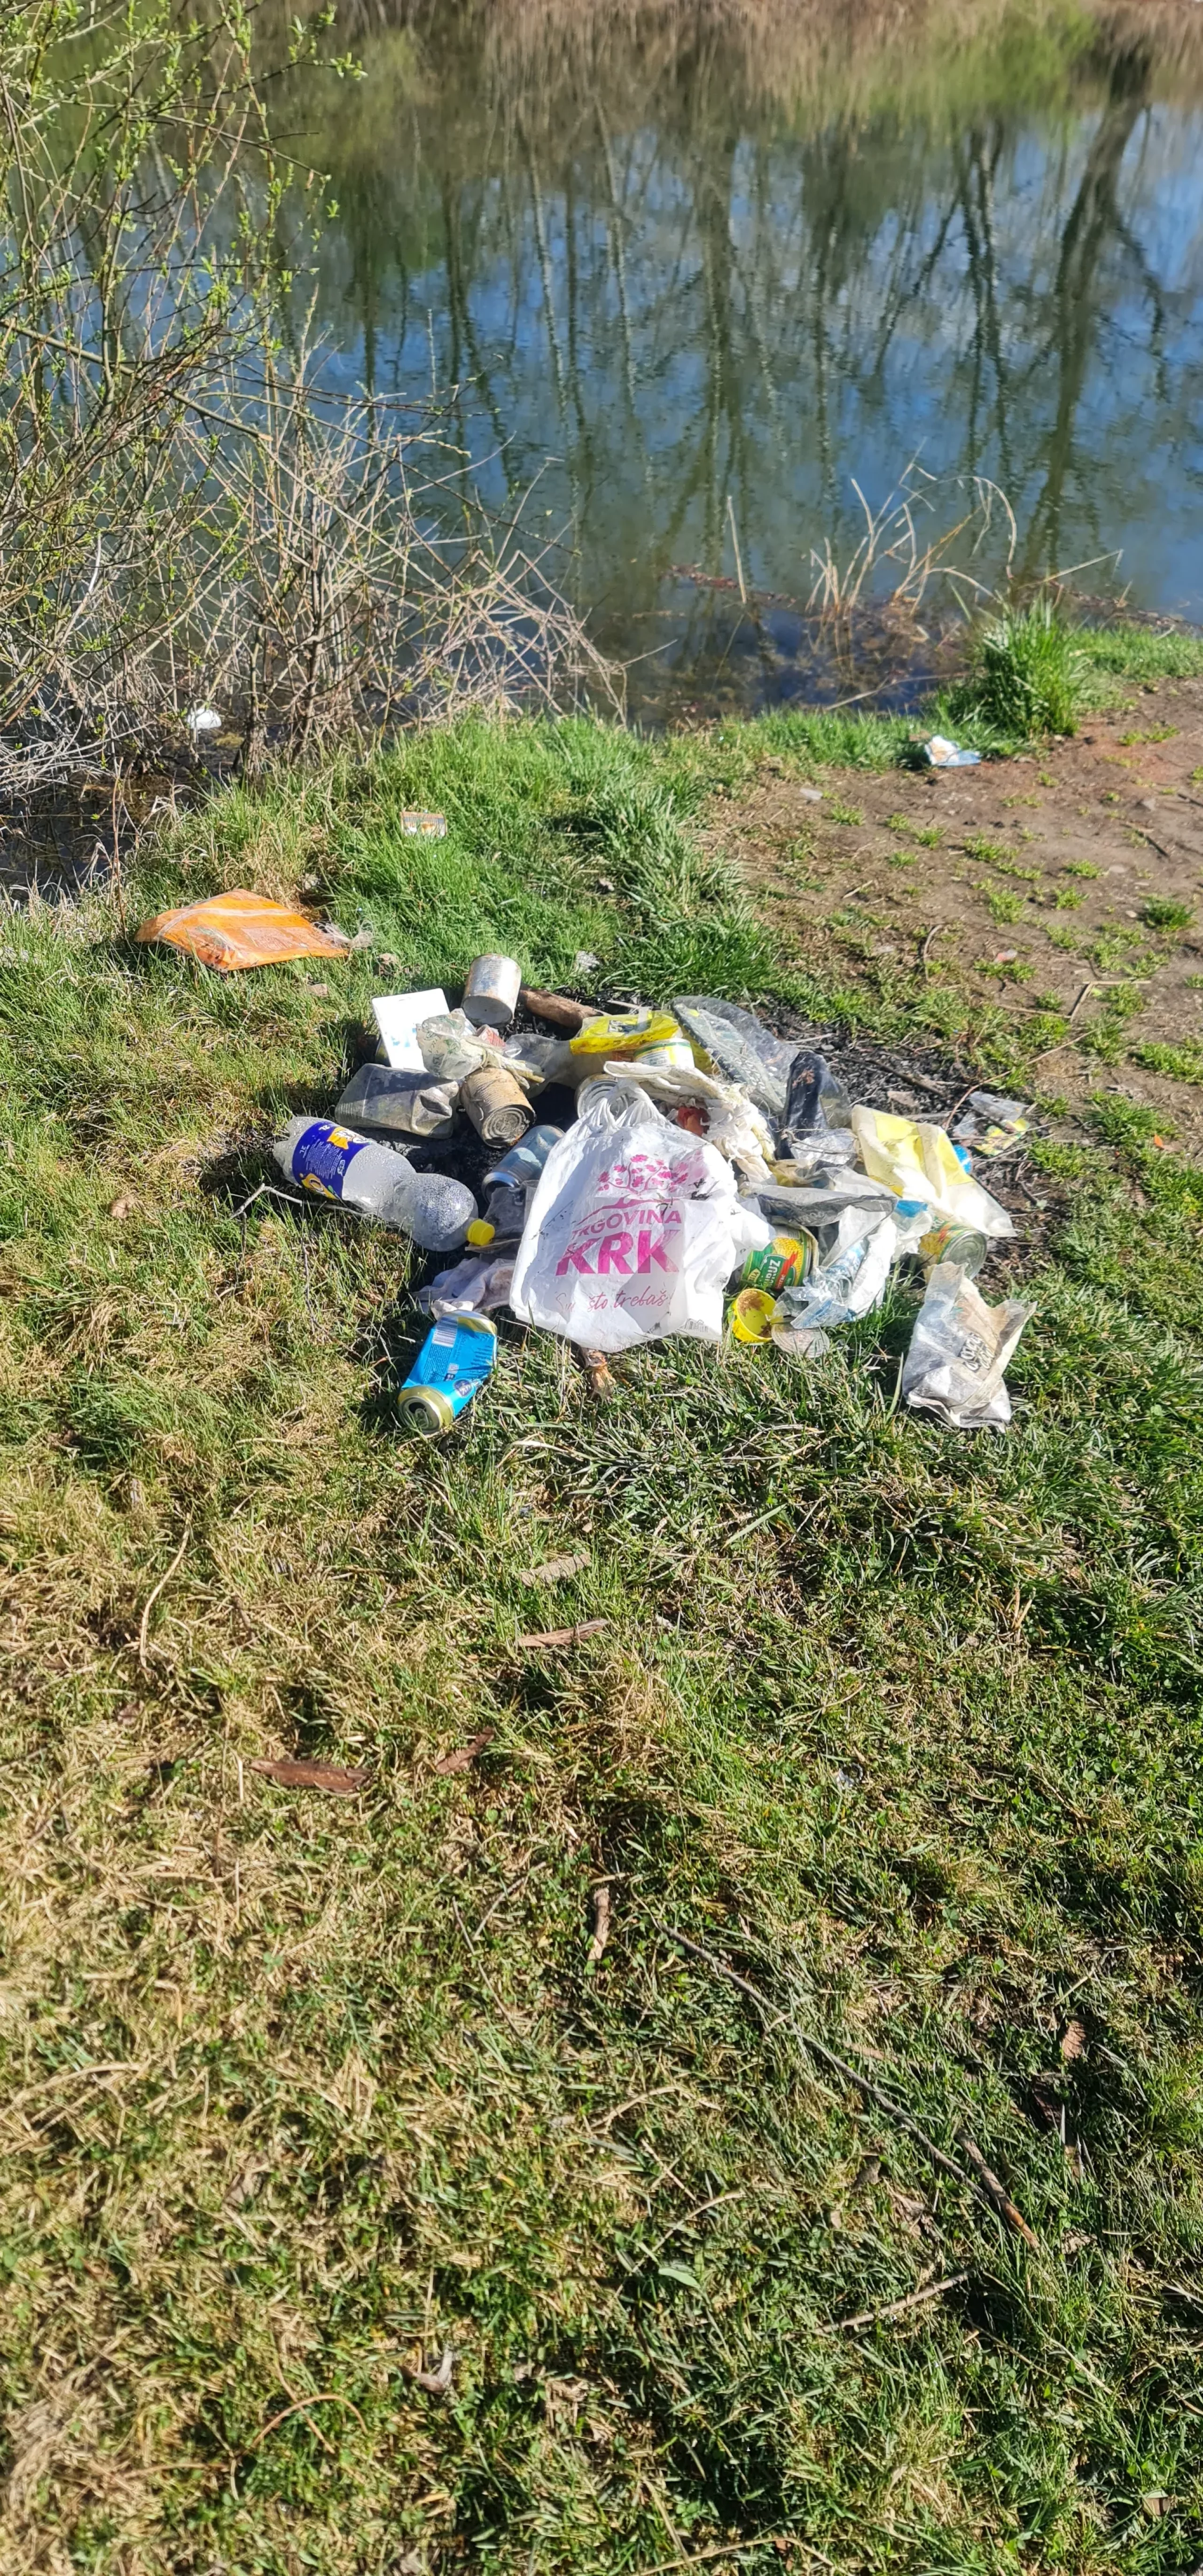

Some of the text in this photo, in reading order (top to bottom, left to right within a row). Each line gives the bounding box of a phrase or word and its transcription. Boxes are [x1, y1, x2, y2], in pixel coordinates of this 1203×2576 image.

[571, 1209, 682, 1240] TRGOVINA
[555, 1229, 681, 1276] KRK
[586, 1292, 609, 1312] što
[613, 1285, 669, 1308] trebaš
